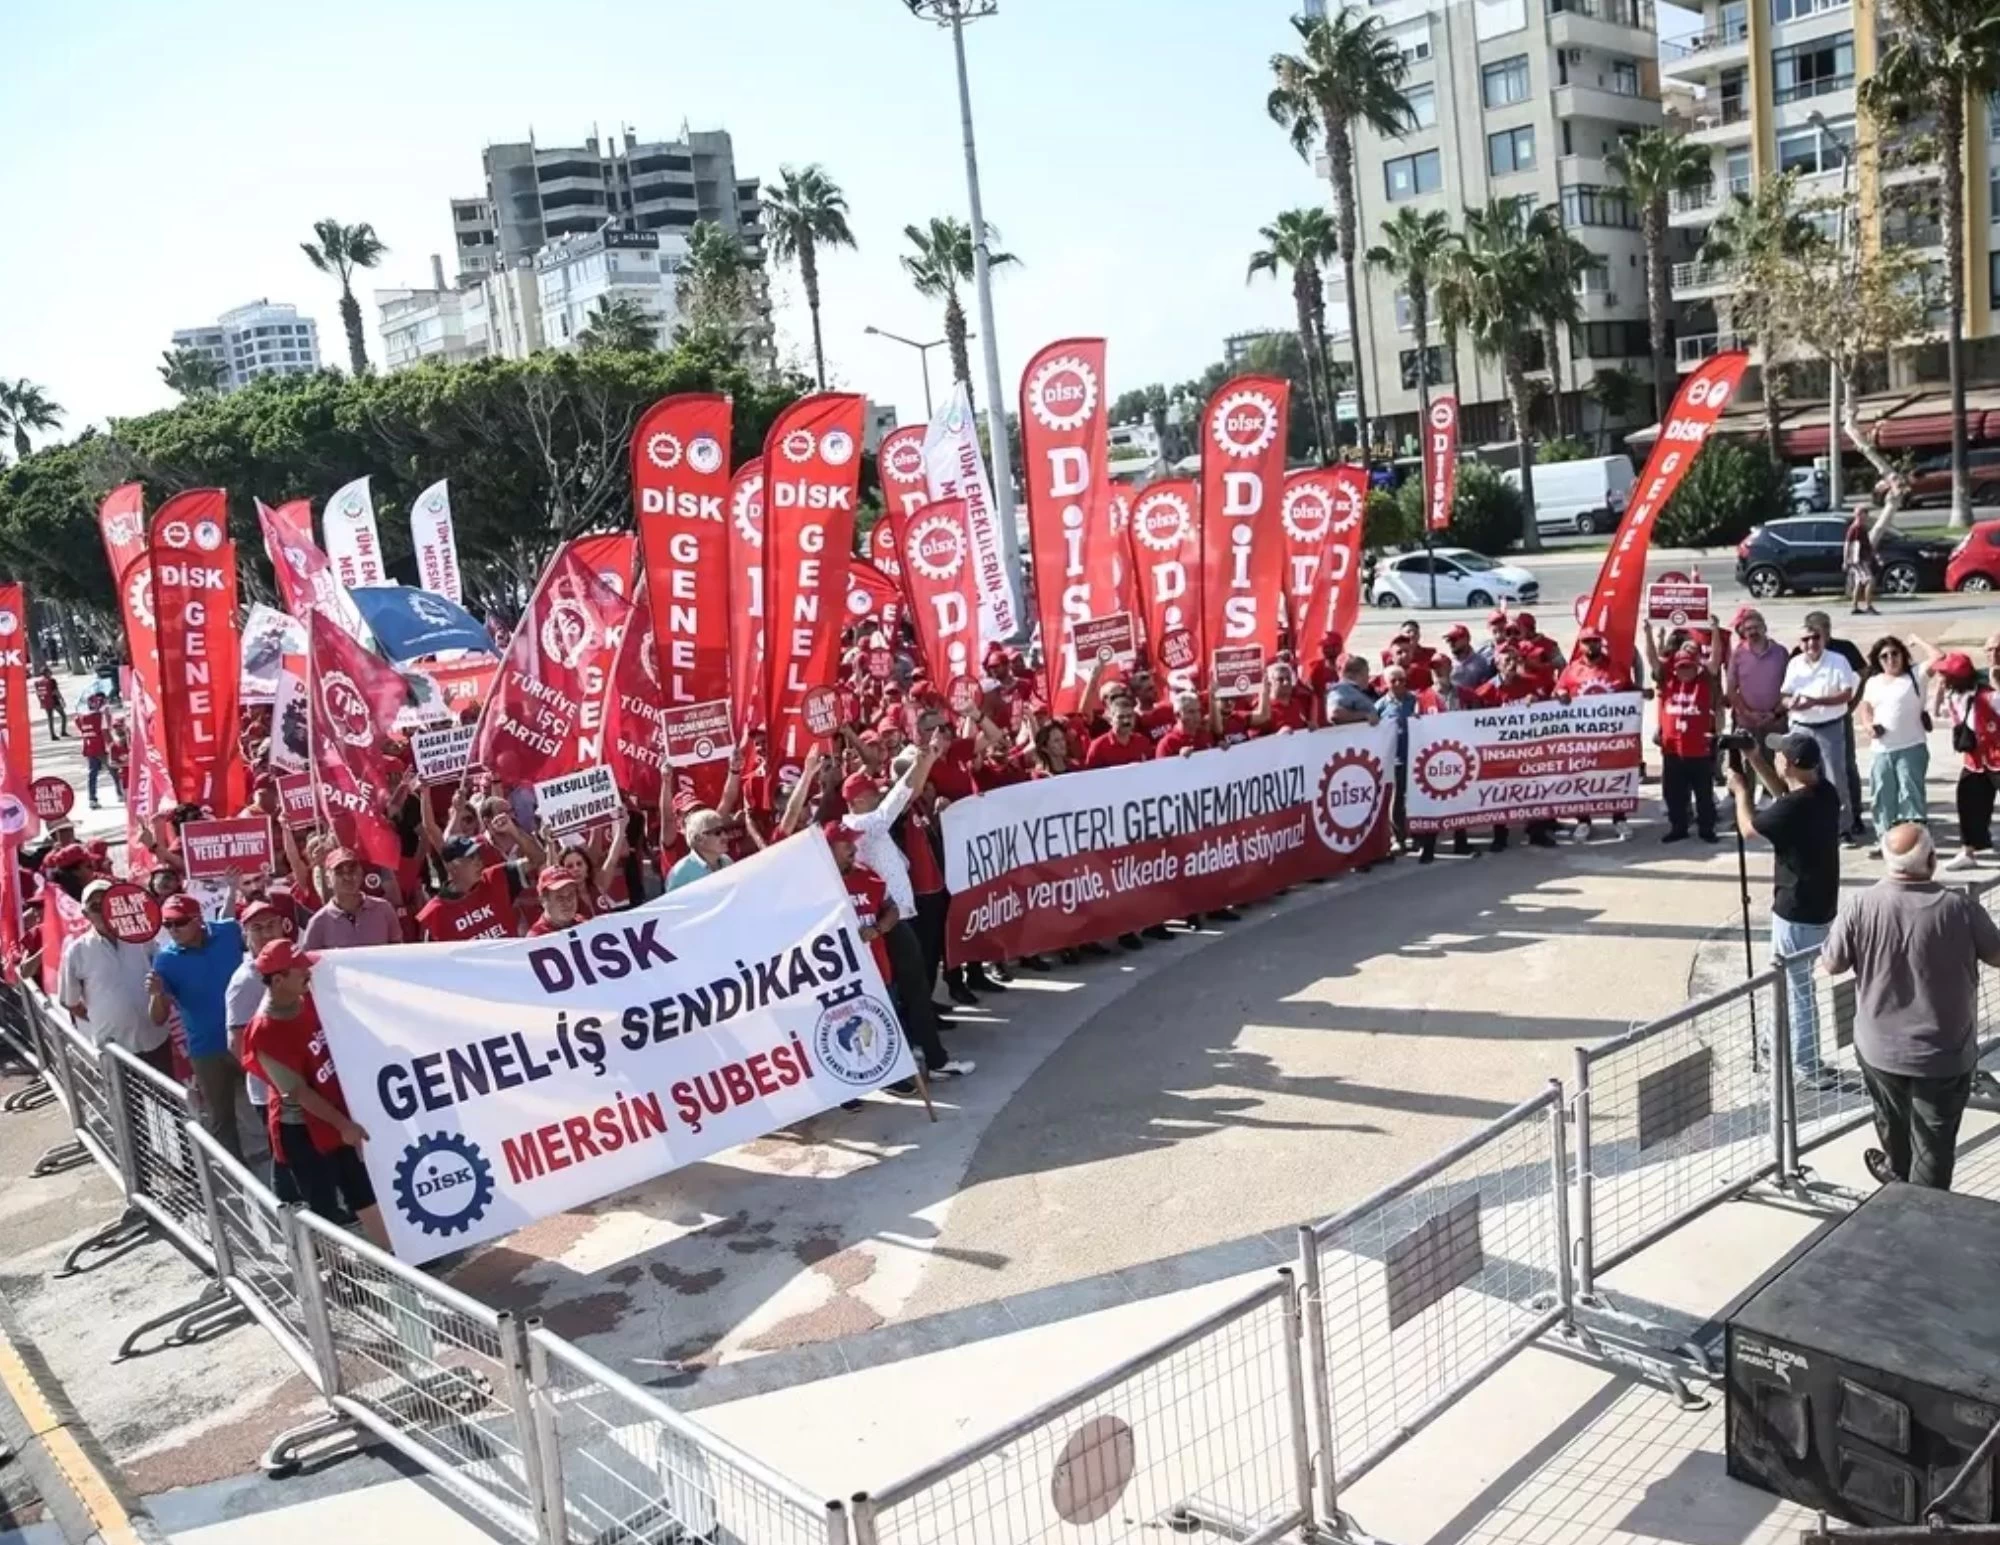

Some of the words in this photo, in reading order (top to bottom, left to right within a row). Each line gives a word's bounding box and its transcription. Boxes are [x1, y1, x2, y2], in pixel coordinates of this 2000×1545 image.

[1045, 382, 1084, 401] DİSK
[1227, 414, 1263, 432] DİSK
[1665, 418, 1711, 442] DİSK
[958, 442, 977, 477] TÜM
[642, 486, 725, 522] DİSK
[774, 478, 851, 511] DİSK
[1293, 505, 1325, 520] DİSK
[355, 526, 374, 556] TÜM
[436, 520, 450, 547] TÜM
[1222, 471, 1263, 642] DİS
[161, 561, 226, 591] DİSK
[334, 687, 364, 717] TİP
[510, 670, 578, 719] TÜRKİYE
[620, 695, 662, 722] TÜRK
[536, 704, 570, 738] İŞÇİ
[1474, 713, 1525, 728] HAYAT
[1498, 725, 1571, 742] ZAMLARA
[1575, 721, 1624, 736] KARŞI
[495, 714, 563, 759] PARTİSİ
[1549, 735, 1637, 756] YAŞANACAK
[423, 753, 467, 777] YÜRÜYO
[1428, 761, 1463, 778] DİSK
[1519, 759, 1564, 775] ÜCRET
[321, 783, 374, 817] PART
[1330, 780, 1375, 808] DİSK
[1478, 772, 1633, 806] YÜRÜYORUZ!
[1442, 810, 1508, 832] ÇUKUROVA
[1510, 805, 1549, 821] BÖLGE
[965, 821, 1021, 887] ARTIK
[1024, 807, 1115, 864] YETER!
[1026, 871, 1111, 915] vergide,
[1110, 846, 1180, 895] ülkede
[1183, 838, 1242, 877] adalet
[1242, 811, 1307, 867] istiyoruz!
[455, 903, 495, 932] DİSK
[527, 918, 679, 995] DİSK
[376, 1011, 607, 1122] GENEL-İŞ
[620, 926, 863, 1052] SENDİKASI
[501, 1090, 668, 1185] MERSİN
[676, 1030, 815, 1136] ŞUBESİ
[415, 1164, 475, 1199] DİSK
